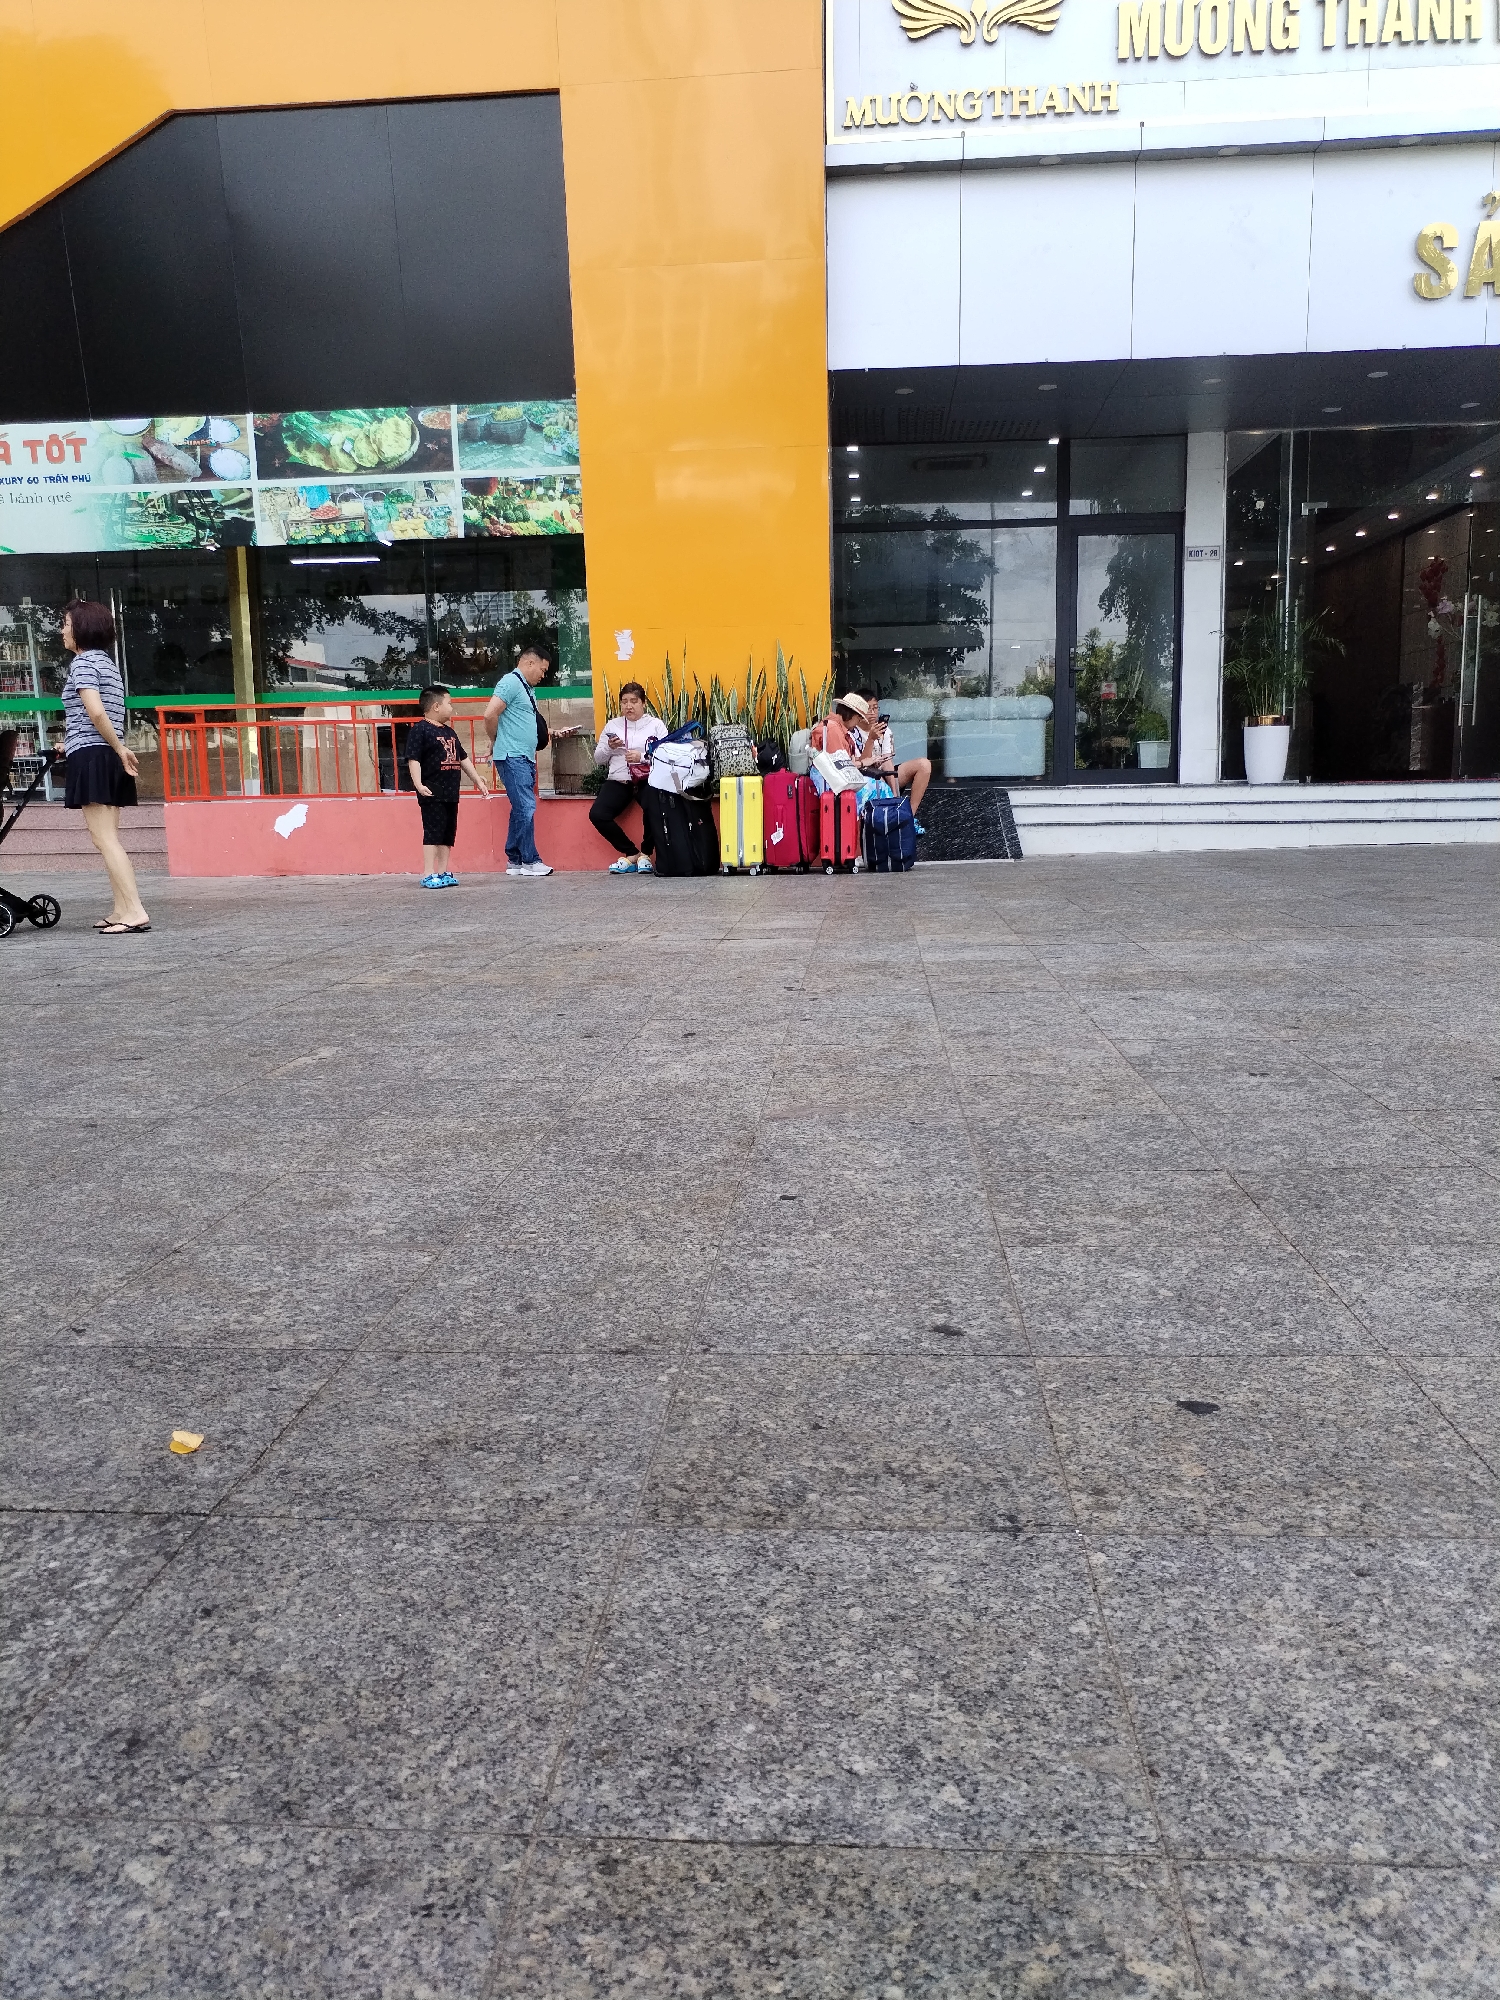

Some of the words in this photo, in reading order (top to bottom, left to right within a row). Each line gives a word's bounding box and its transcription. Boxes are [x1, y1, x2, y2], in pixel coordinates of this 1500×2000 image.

[23, 431, 87, 464] TỐT
[26, 476, 40, 485] 60
[72, 472, 91, 483] PHÚ
[47, 491, 73, 505] quê
